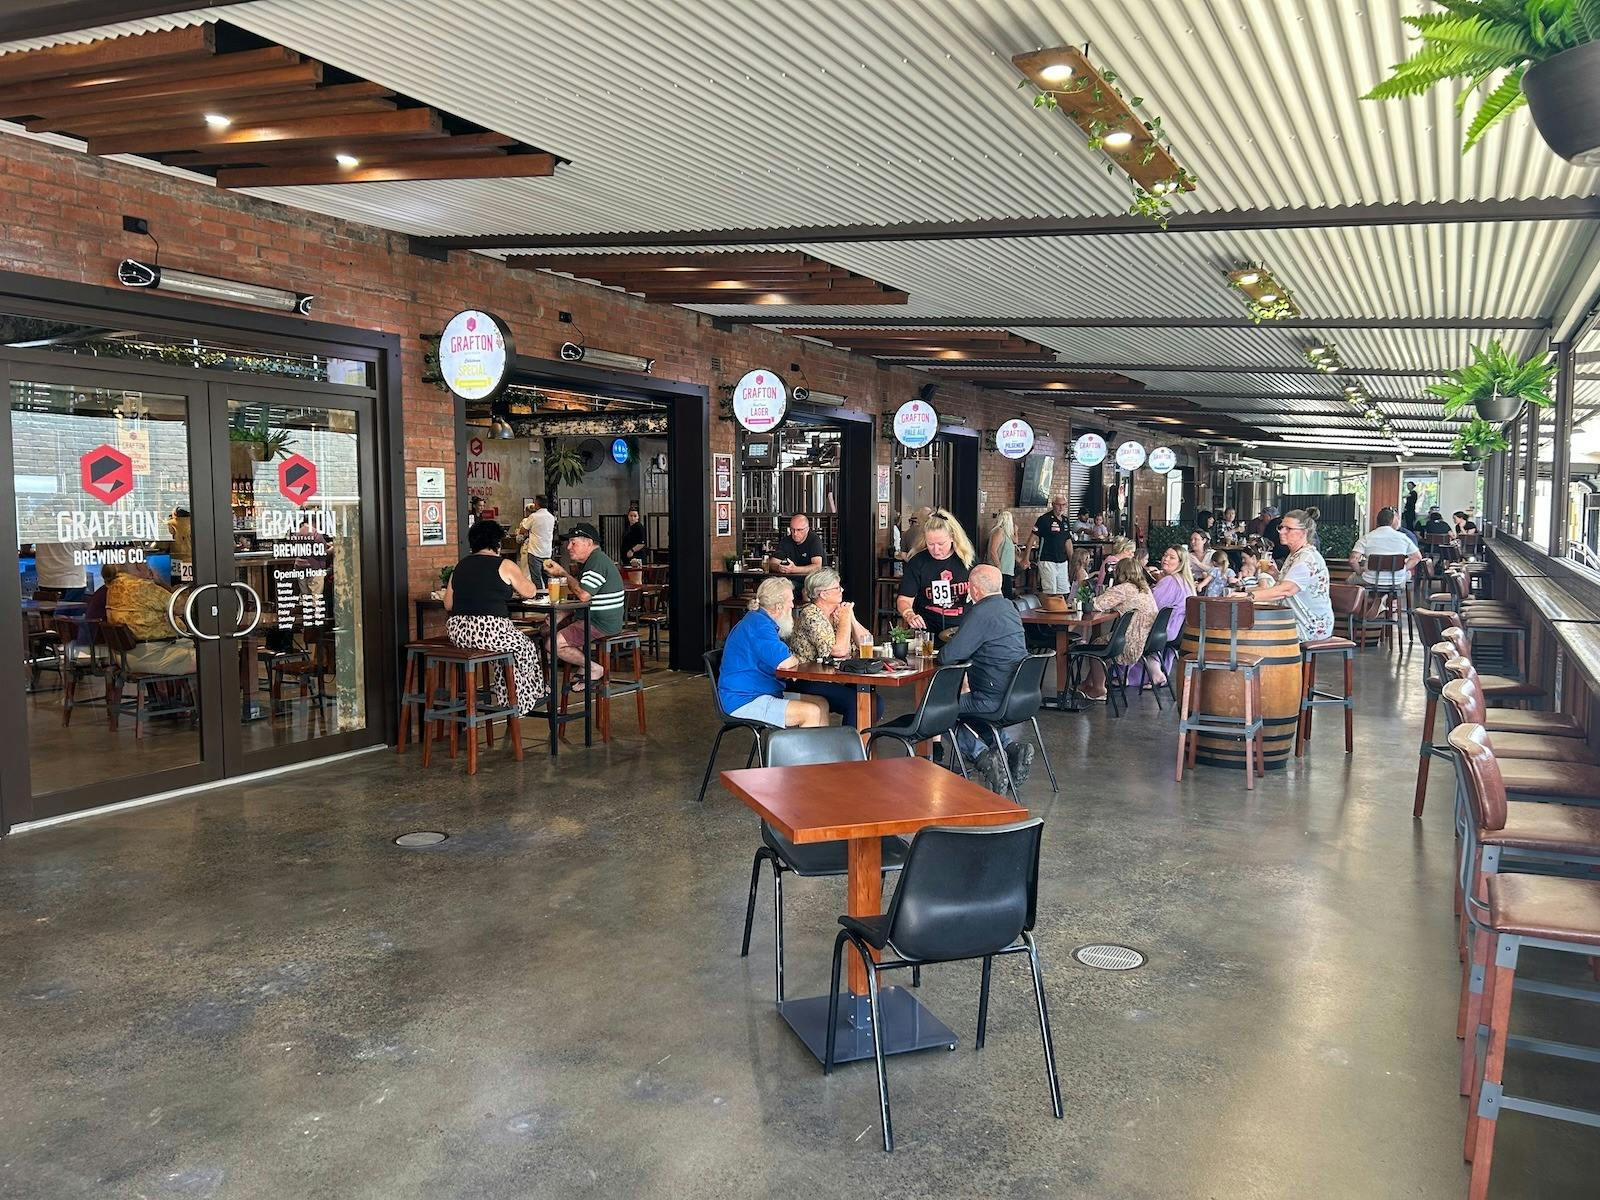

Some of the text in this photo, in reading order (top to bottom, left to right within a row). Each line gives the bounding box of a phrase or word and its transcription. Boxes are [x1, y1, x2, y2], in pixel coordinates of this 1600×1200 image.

[451, 334, 493, 353] GRAFTON
[459, 363, 486, 376] SPECIAL
[742, 386, 777, 400] GRAFTON
[750, 407, 769, 417] LAGER
[901, 413, 930, 424] GRAFTON
[1002, 430, 1027, 439] GRAFTON
[466, 461, 500, 482] AFTON
[57, 510, 160, 542] GRAFTON
[261, 510, 337, 538] GRAFTON
[73, 548, 147, 566] BREWING CO.
[273, 542, 327, 558] BREWING CO.
[182, 565, 194, 577] 20
[274, 568, 327, 580] Opening Hours
[925, 581, 971, 600] GTON
[933, 585, 949, 600] 35
